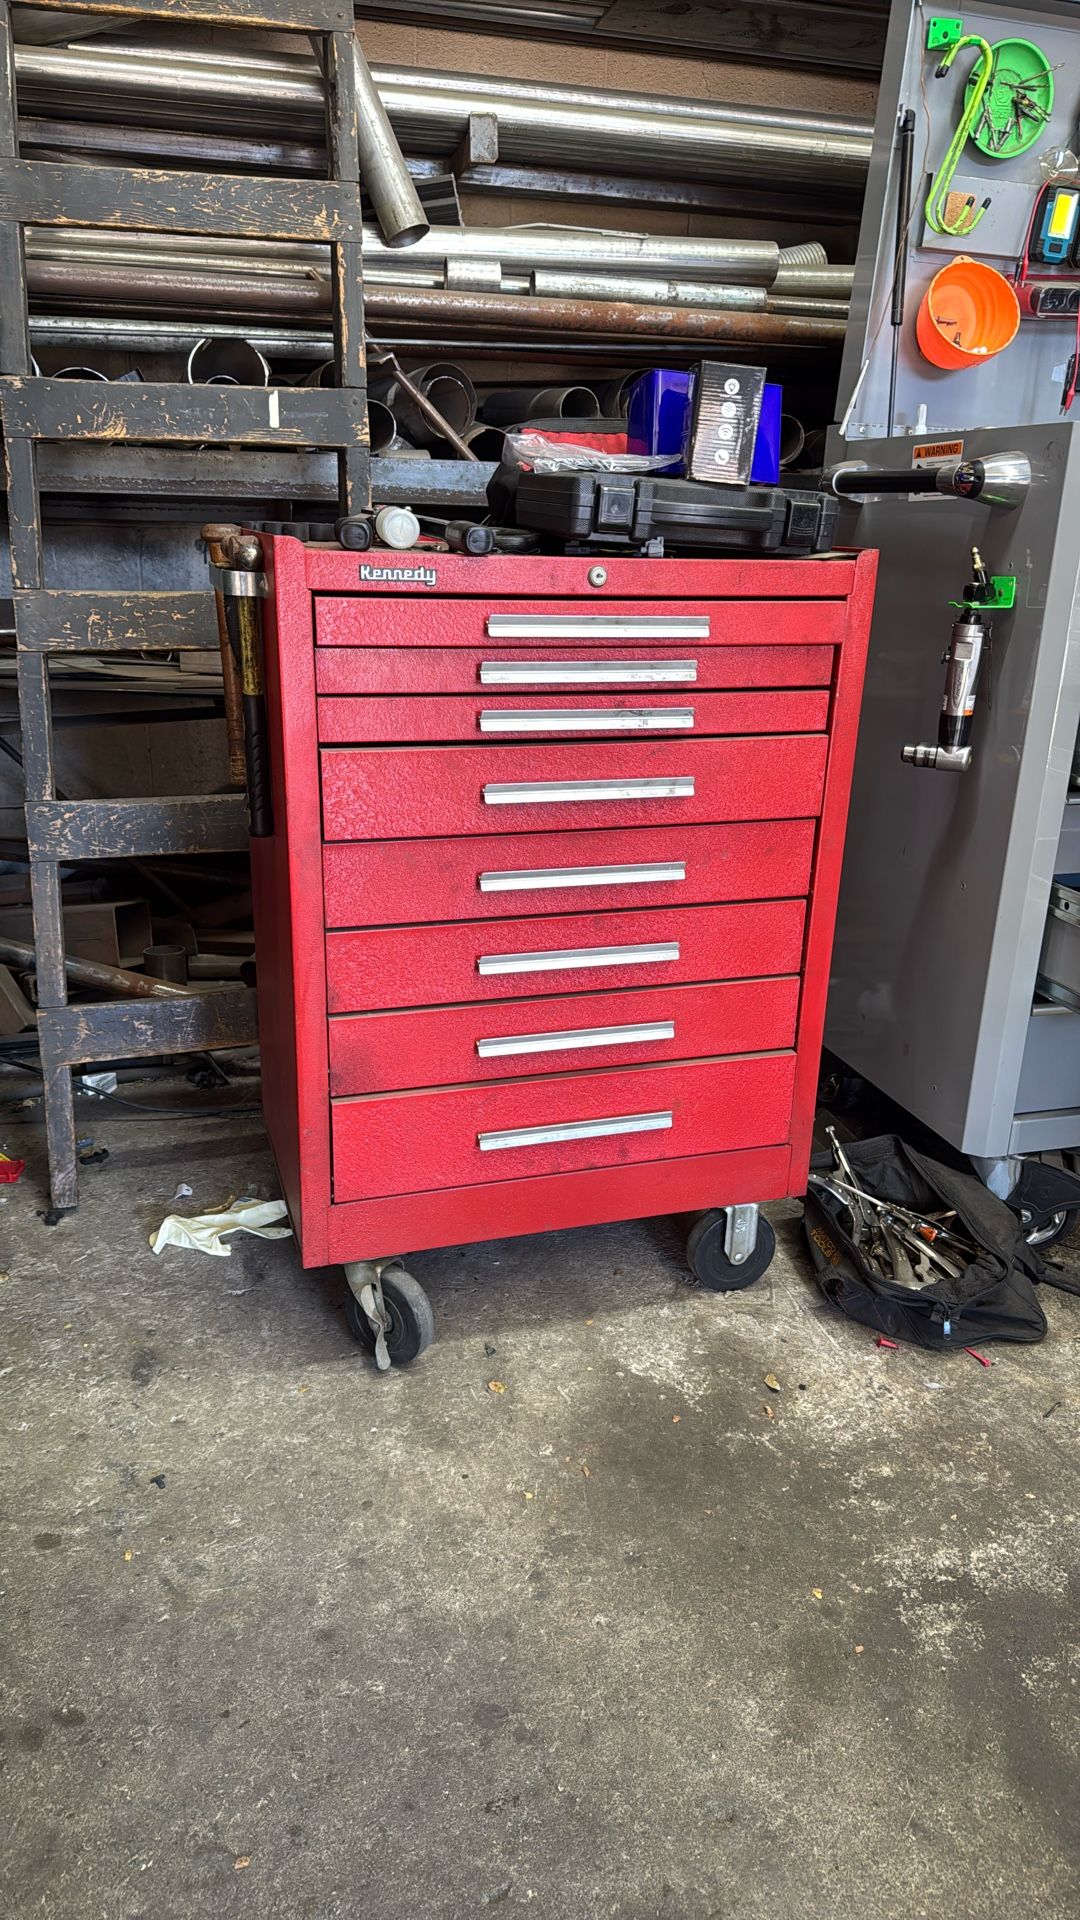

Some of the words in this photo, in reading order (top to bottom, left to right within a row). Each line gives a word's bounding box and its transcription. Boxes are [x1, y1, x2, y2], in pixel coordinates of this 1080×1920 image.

[924, 444, 959, 457] WARNING
[360, 565, 437, 586] Kennedy
[811, 1230, 832, 1257] TOOLS
